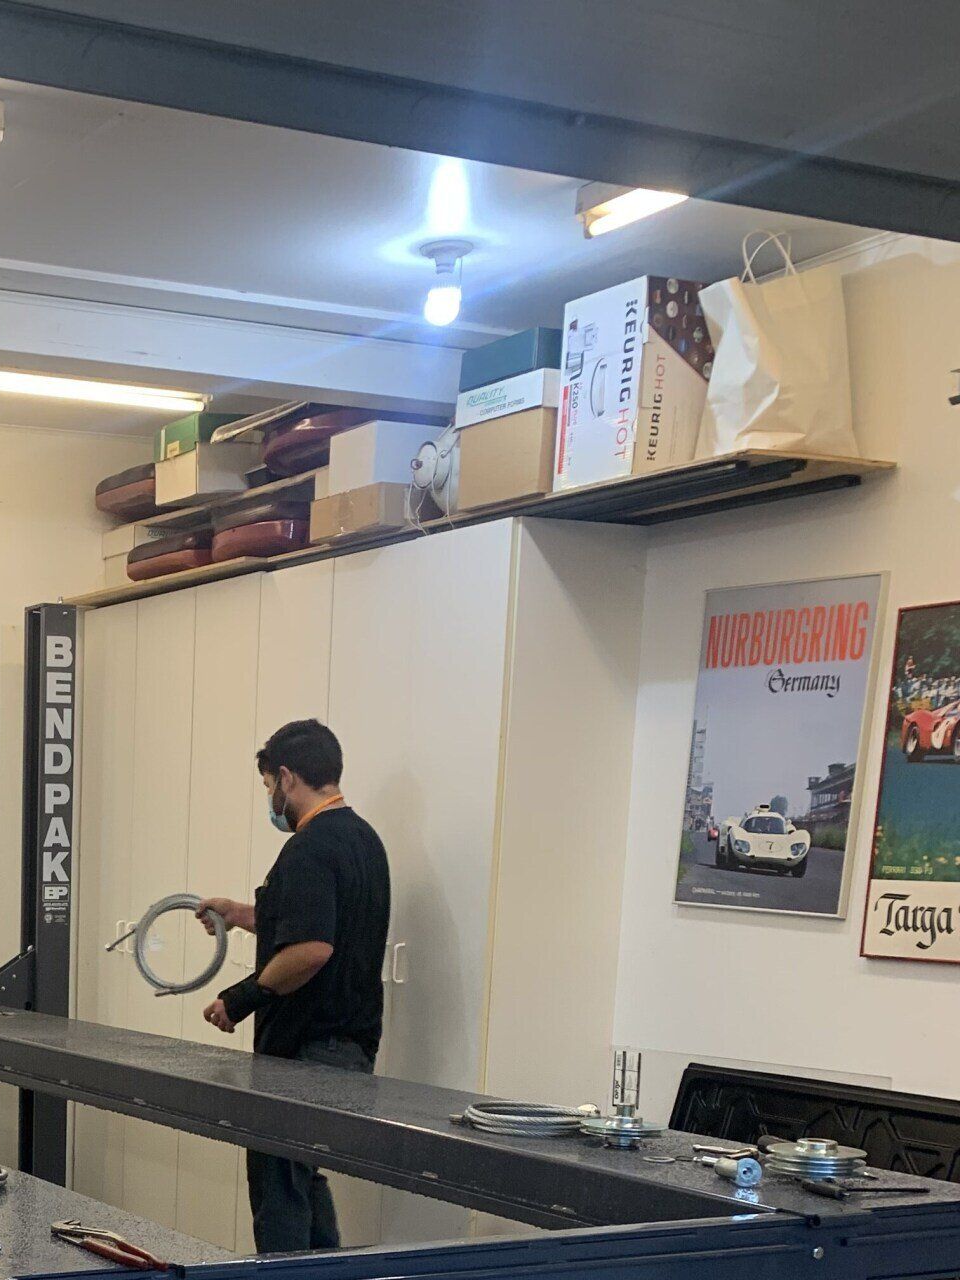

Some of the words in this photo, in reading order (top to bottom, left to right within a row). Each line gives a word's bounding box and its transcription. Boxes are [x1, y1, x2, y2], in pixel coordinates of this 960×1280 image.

[619, 299, 638, 403] KEURIG
[654, 355, 666, 390] HOT
[614, 407, 630, 460] HOT
[647, 393, 663, 461] KEURIG
[706, 601, 869, 669] NURBURGRING
[766, 669, 840, 697] Germany
[42, 635, 73, 882] BENDPAK
[45, 886, 68, 900] BP
[874, 893, 954, 950] Targa
